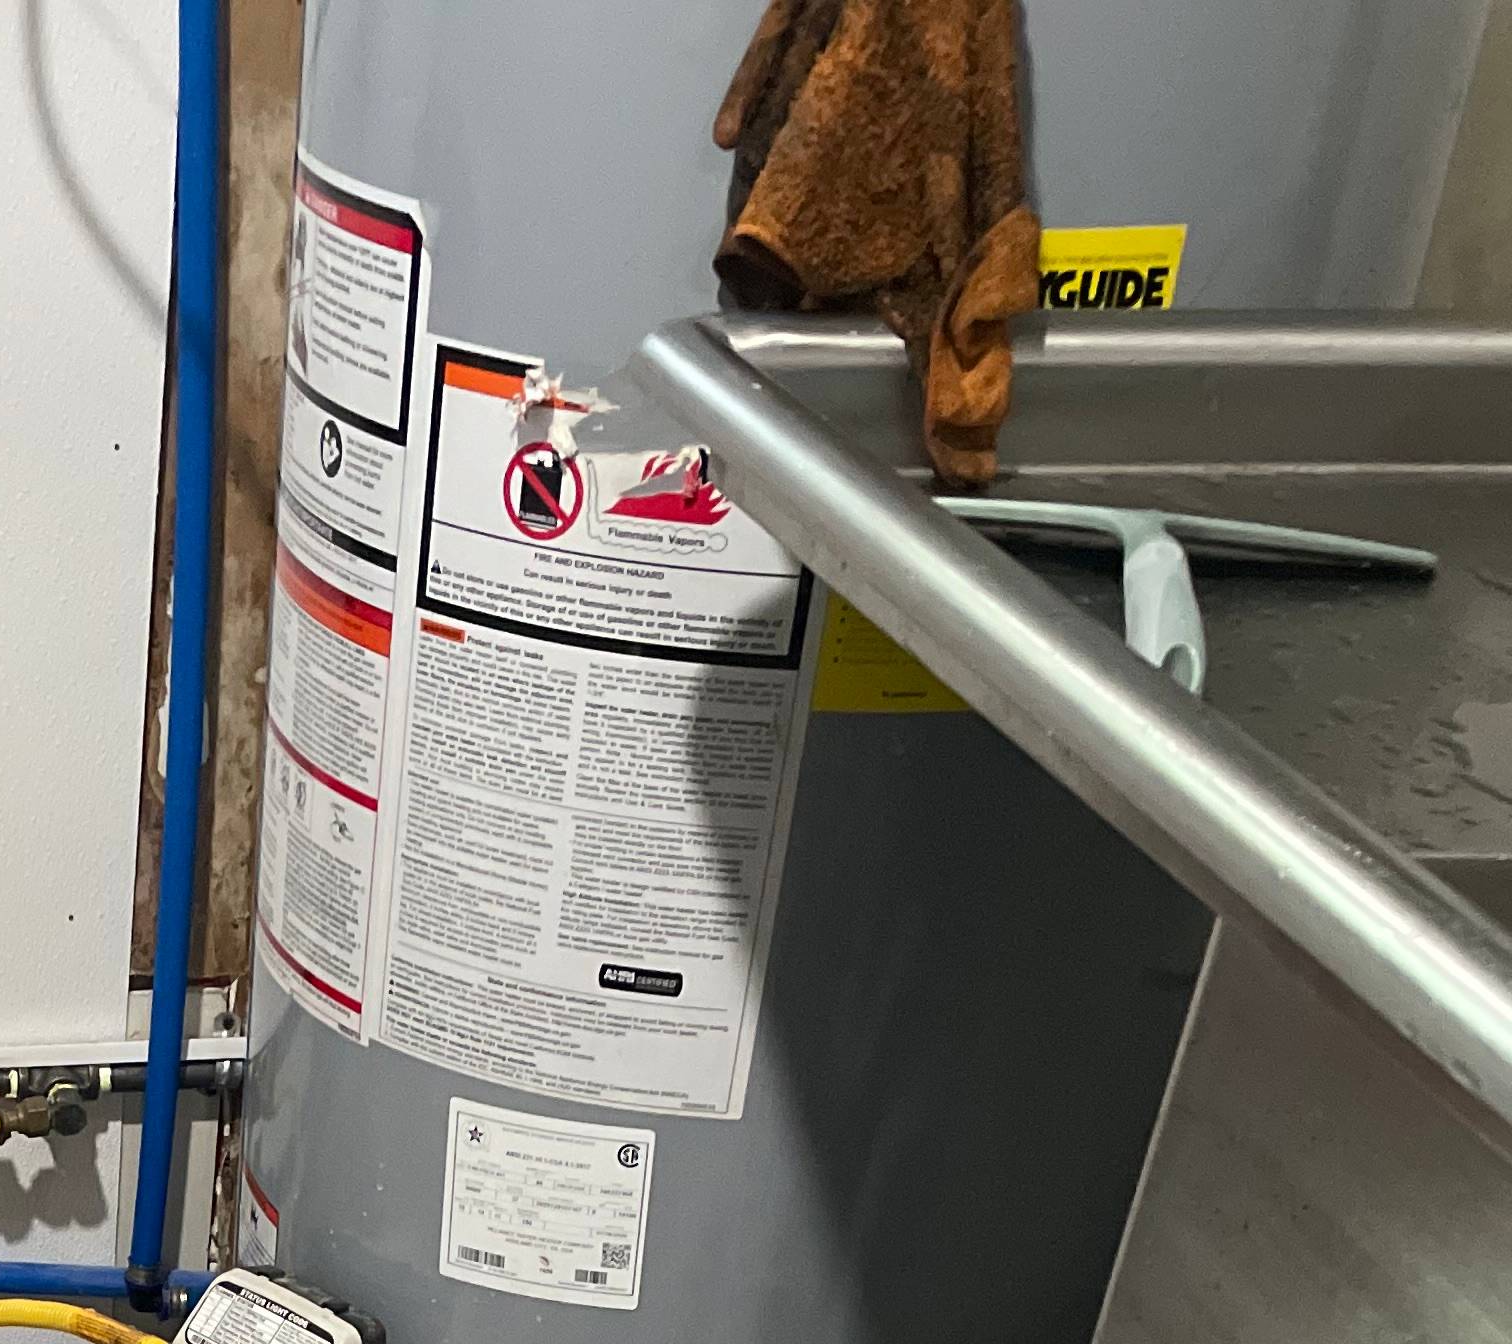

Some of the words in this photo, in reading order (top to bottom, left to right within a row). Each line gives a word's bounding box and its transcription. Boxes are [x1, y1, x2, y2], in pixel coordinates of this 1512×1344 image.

[608, 527, 663, 542] Flammable
[668, 535, 705, 547] Vapors
[534, 553, 552, 563] FIRE
[555, 557, 572, 567] AND
[575, 560, 624, 575] EXPLOSION
[627, 568, 664, 580] HAZARD
[240, 1288, 266, 1308] STATUS
[266, 1298, 288, 1318] LIGHT
[288, 1309, 309, 1329] CODE
